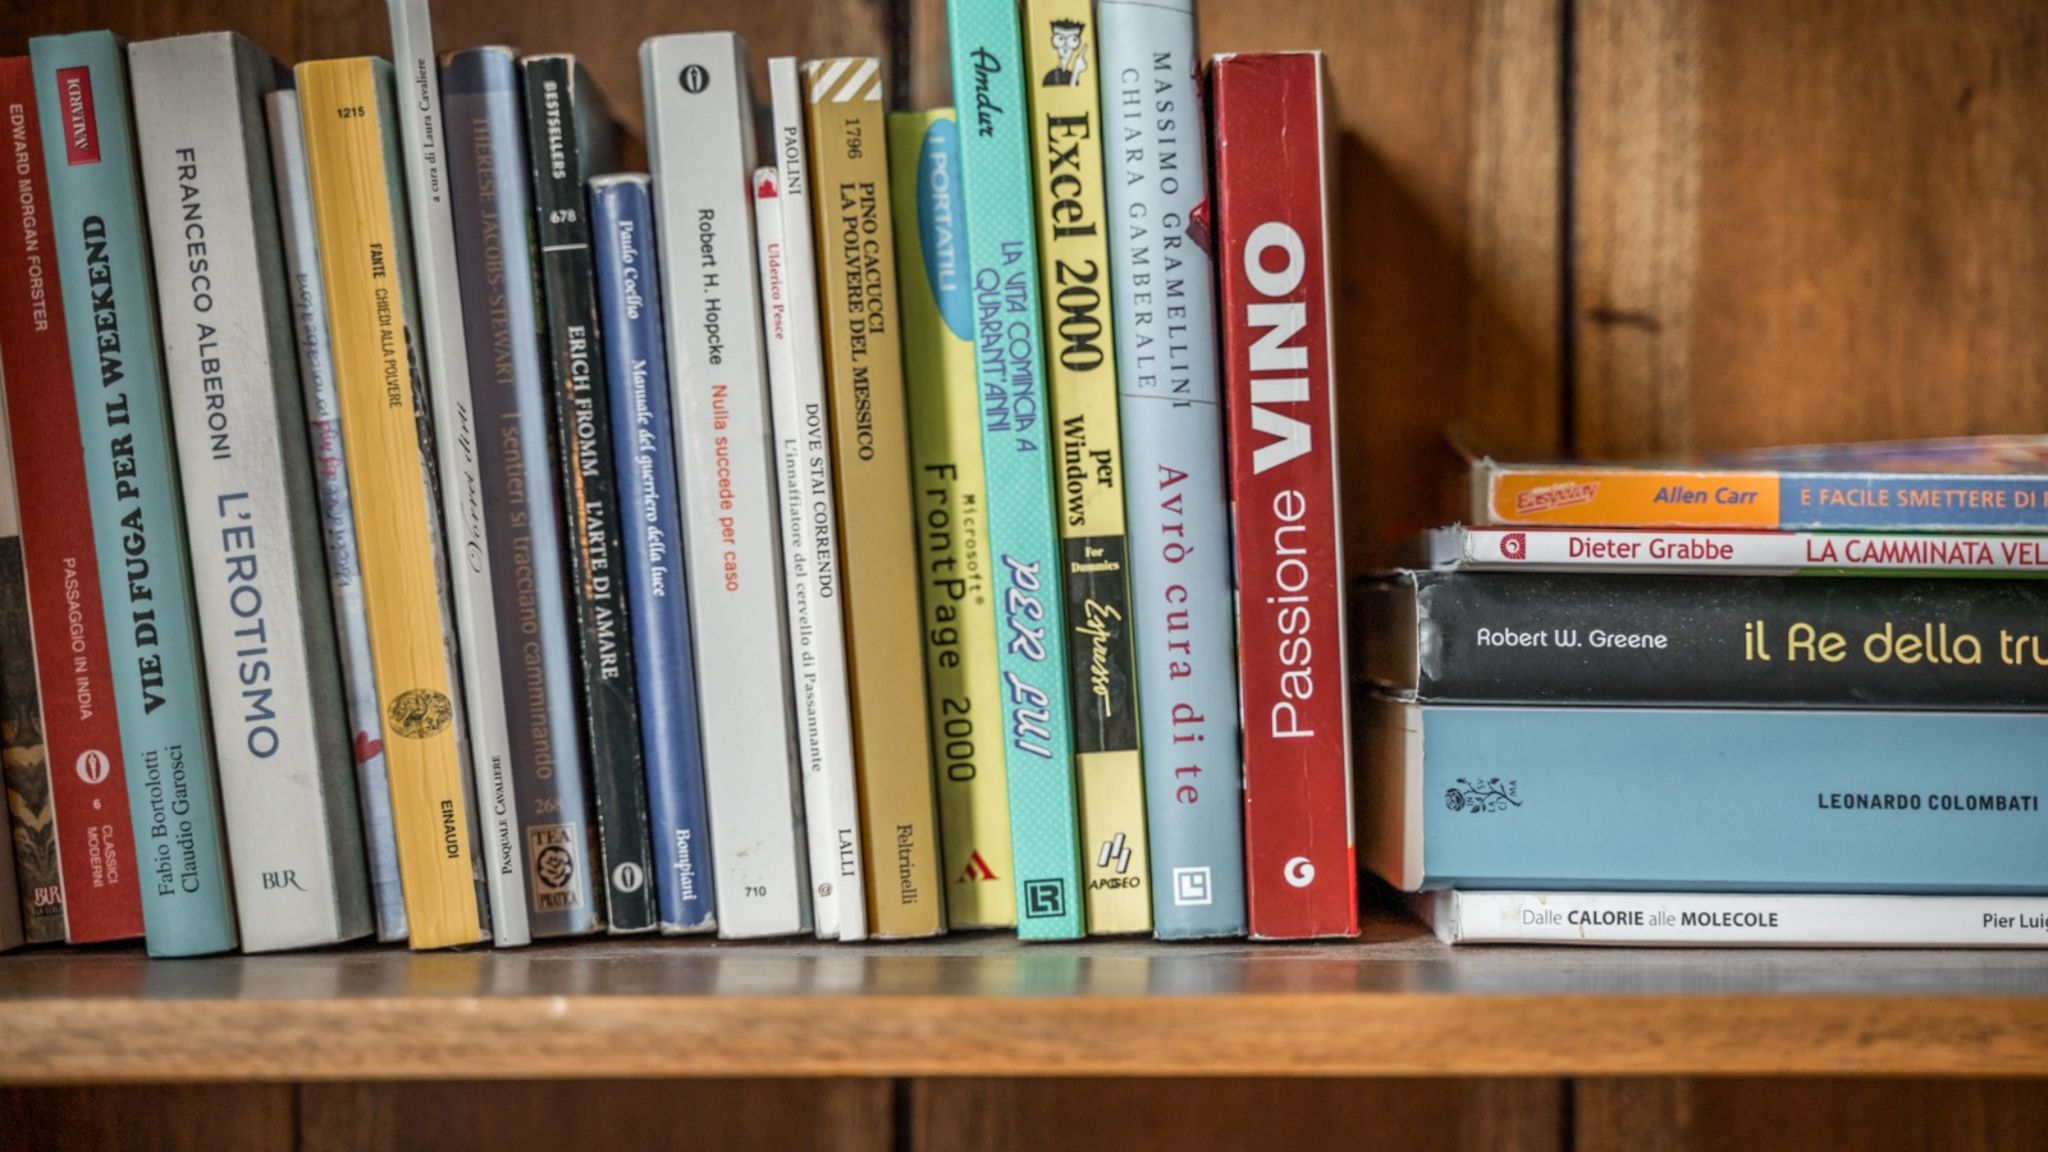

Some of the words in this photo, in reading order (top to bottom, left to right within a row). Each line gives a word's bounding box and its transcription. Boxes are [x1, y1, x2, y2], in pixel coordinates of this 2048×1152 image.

[336, 106, 365, 120] 1215
[415, 58, 432, 110] Cavaliere
[970, 46, 1003, 138] Amdur
[10, 103, 31, 177] EDWARD
[420, 112, 436, 142] Laura
[424, 145, 436, 163] di
[542, 80, 567, 180] BESTSELLERS
[845, 118, 863, 159] 1796
[1121, 67, 1146, 187] CHIARA
[1153, 51, 1179, 197] MASSIMO
[428, 166, 440, 192] cura
[783, 126, 802, 195] PAOLINI
[1046, 111, 1098, 242] Excel
[19, 179, 39, 253] MORGAN
[549, 208, 577, 224] 678
[840, 183, 857, 213] LA
[859, 182, 876, 231] PINO
[929, 151, 957, 292] PORTATILI
[369, 243, 387, 279] FANTE
[619, 219, 637, 267] Paulo
[698, 208, 714, 270] Robert
[841, 216, 865, 320] POLVERE
[1001, 241, 1024, 266] LA
[28, 254, 49, 333] FORSTER
[82, 214, 122, 387] WEEKEND
[624, 268, 643, 320] Coelho
[704, 273, 719, 294] H.
[767, 243, 784, 300] Ulderico
[863, 234, 885, 334] CACUCCI
[1005, 272, 1028, 314] VITA
[1128, 202, 1157, 389] GAMBERALE
[175, 147, 214, 313] FRANCESCO
[196, 323, 232, 461] ALBERONI
[374, 288, 392, 325] CHIEDI
[703, 298, 724, 366] Hopcke
[772, 303, 785, 340] Pesce
[1055, 259, 1104, 373] 2000
[1162, 212, 1192, 409] GRAMELLINI
[379, 327, 395, 354] ALLA
[568, 325, 593, 391] ERICH
[849, 323, 868, 361] DEL
[974, 267, 1012, 433] QUARANT'ANNI
[1243, 221, 1313, 475] VINO
[384, 356, 402, 409] POLVERE
[632, 359, 652, 426] Manuale
[1008, 320, 1038, 433] COMINCIA
[106, 392, 129, 427] IL
[574, 391, 600, 478] FROMM
[712, 384, 728, 431] Nulla
[805, 403, 823, 451] DOVE
[852, 367, 875, 461] MESSICO
[112, 438, 142, 501] PER
[638, 429, 654, 452] del
[1017, 436, 1039, 453] A
[1061, 414, 1086, 526] Windows
[1089, 448, 1113, 489] per
[636, 454, 659, 522] guerriero
[715, 434, 733, 511] succede
[809, 456, 826, 496] STAI
[1653, 487, 1708, 505] Allen
[1714, 487, 1759, 505] Carr
[1819, 488, 1888, 506] FACILE
[1897, 489, 2006, 508] SMETTERE
[2015, 490, 2035, 508] DI
[585, 501, 608, 571] L'ARTE
[646, 524, 665, 563] della
[719, 514, 735, 546] per
[1157, 463, 1195, 565] Avrò
[123, 506, 154, 602] FUGA
[723, 549, 738, 592] caso
[793, 553, 808, 578] del
[813, 501, 833, 599] CORRENDO
[922, 464, 966, 669] FrontPage
[1071, 560, 1121, 573] Dummies
[1085, 546, 1105, 558] For
[1568, 537, 1642, 559] Dieter
[1649, 538, 1734, 560] Grabbe
[1807, 539, 1838, 562] LA
[1845, 539, 1994, 564] CAMMINATA
[62, 557, 86, 654] PASSAGGIO
[513, 534, 537, 634] tracciano
[590, 575, 611, 602] DI
[653, 566, 666, 598] luce
[1002, 554, 1048, 662] PER
[132, 607, 159, 648] DI
[217, 491, 280, 760] L'EROTISMO
[594, 605, 619, 680] AMARE
[795, 582, 813, 647] cervello
[1165, 583, 1194, 682] cura
[1267, 489, 1315, 738] Passione
[1477, 628, 1548, 647] Robert
[1554, 629, 1583, 648] W.
[1589, 630, 1668, 649] Greene
[1745, 620, 1771, 661] il
[1788, 622, 1847, 662] Re
[1863, 622, 1982, 664] della
[74, 656, 88, 674] IN
[139, 654, 167, 715] VIE
[801, 651, 816, 667] di
[75, 675, 94, 721] INDIA
[523, 640, 556, 781] camminando
[803, 672, 825, 773] Passannante
[1003, 671, 1055, 758] LUI
[1170, 702, 1206, 745] di
[943, 698, 977, 782] 2000
[140, 749, 169, 836] Bortolotti
[163, 744, 191, 816] Garosci
[492, 755, 508, 816] CAVALIERE
[1175, 766, 1203, 805] te
[1818, 793, 1921, 810] LEONARDO
[1928, 794, 2038, 811] COLOMBATI
[87, 825, 104, 889] MODERNI
[102, 824, 119, 884] CLASSICI
[177, 822, 200, 893] Claudio
[440, 799, 459, 860] EINAUDI
[534, 830, 571, 845] TEA
[838, 828, 856, 877] LALLI
[157, 837, 176, 898] Fabio
[261, 868, 309, 892] BUR
[675, 828, 698, 902] Bompiani
[745, 885, 767, 898] 710
[897, 824, 918, 905] Feltrinelli
[1522, 908, 1562, 927] Dalle
[1567, 909, 1644, 927] CALORIE
[1648, 909, 1676, 927] alle
[1681, 910, 1779, 928] MOLECOLE
[1983, 912, 2015, 929] Pier
